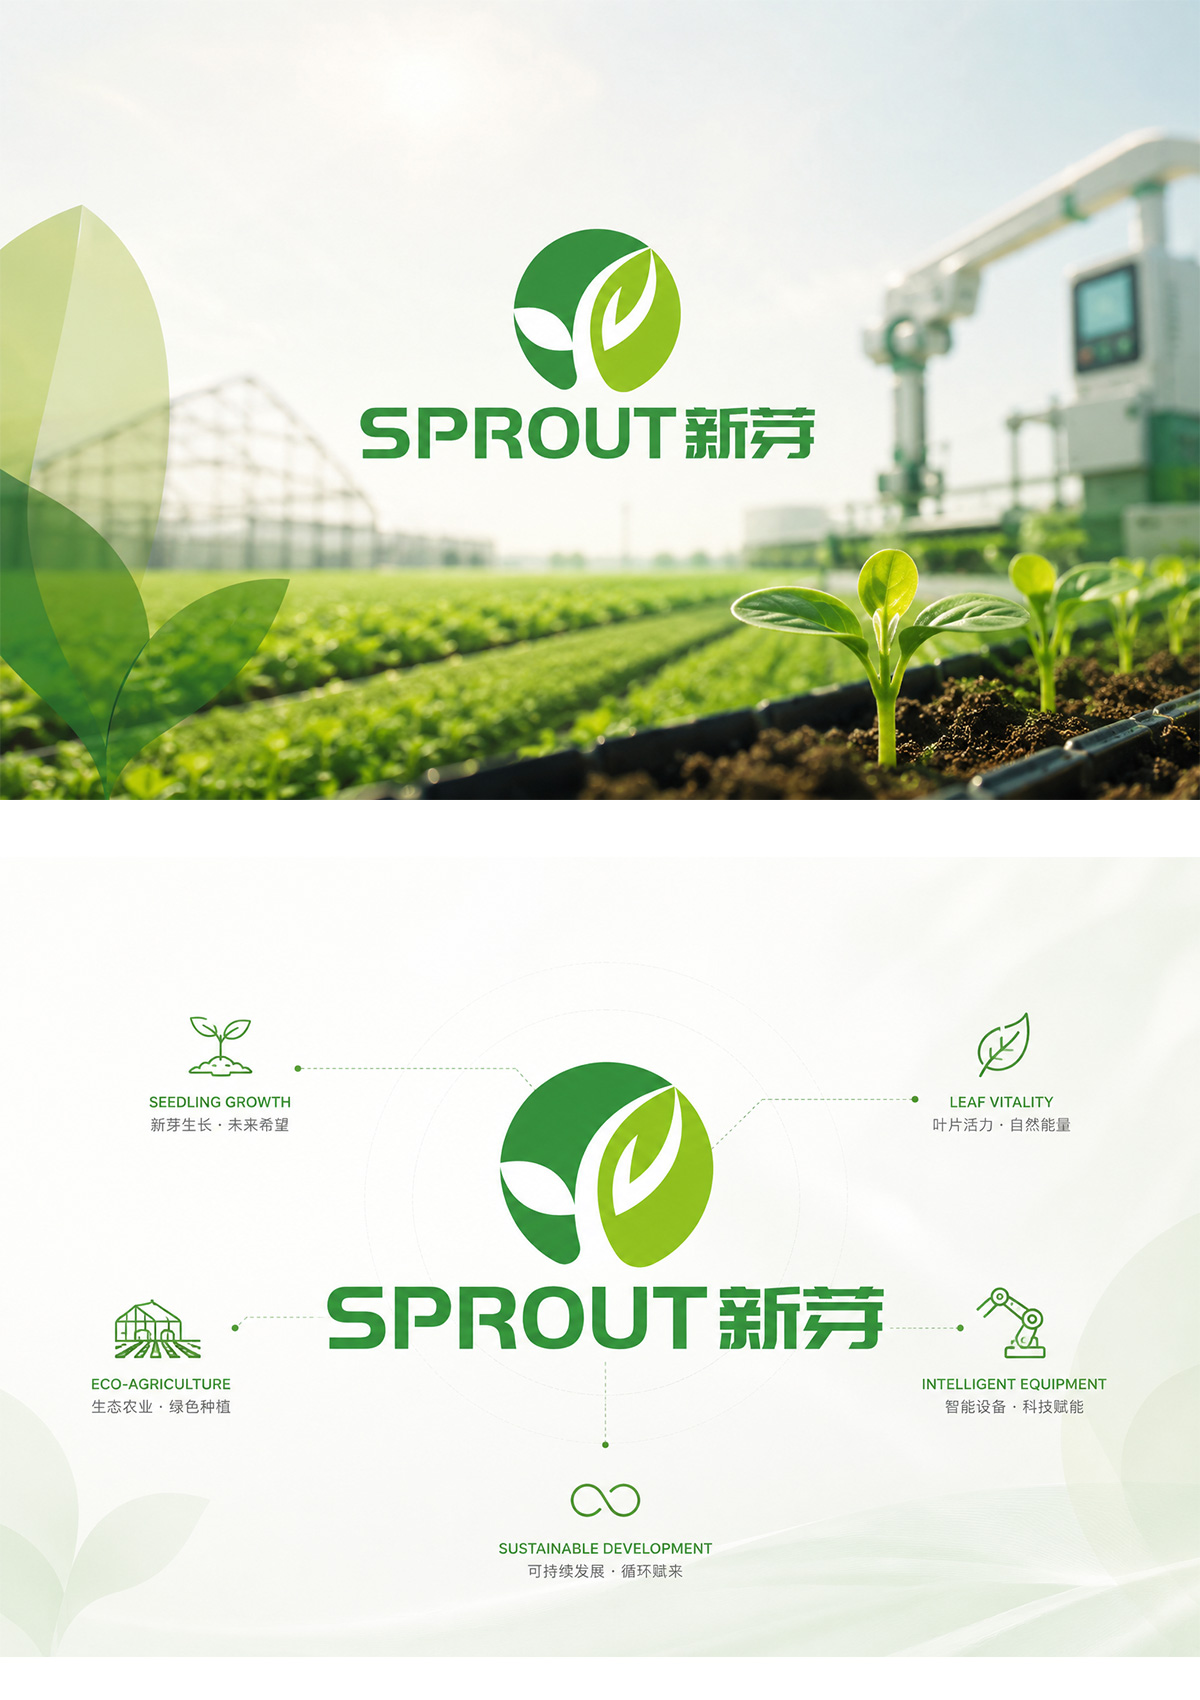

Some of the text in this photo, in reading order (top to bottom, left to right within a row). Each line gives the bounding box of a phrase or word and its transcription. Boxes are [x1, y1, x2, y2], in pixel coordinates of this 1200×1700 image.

[360, 407, 815, 459] SPROUT 新芽
[149, 1096, 291, 1108] SEEDLING GROWTH
[950, 1096, 1053, 1108] LEAF VITALITY
[327, 1286, 885, 1350] SPROUT 新芽
[91, 1378, 231, 1390] ECO-AGRICULTURE
[922, 1378, 1107, 1391] INTELLIGENT EQUIPMENT
[498, 1542, 713, 1555] SUSTAINABLE DEVELOPMENT
